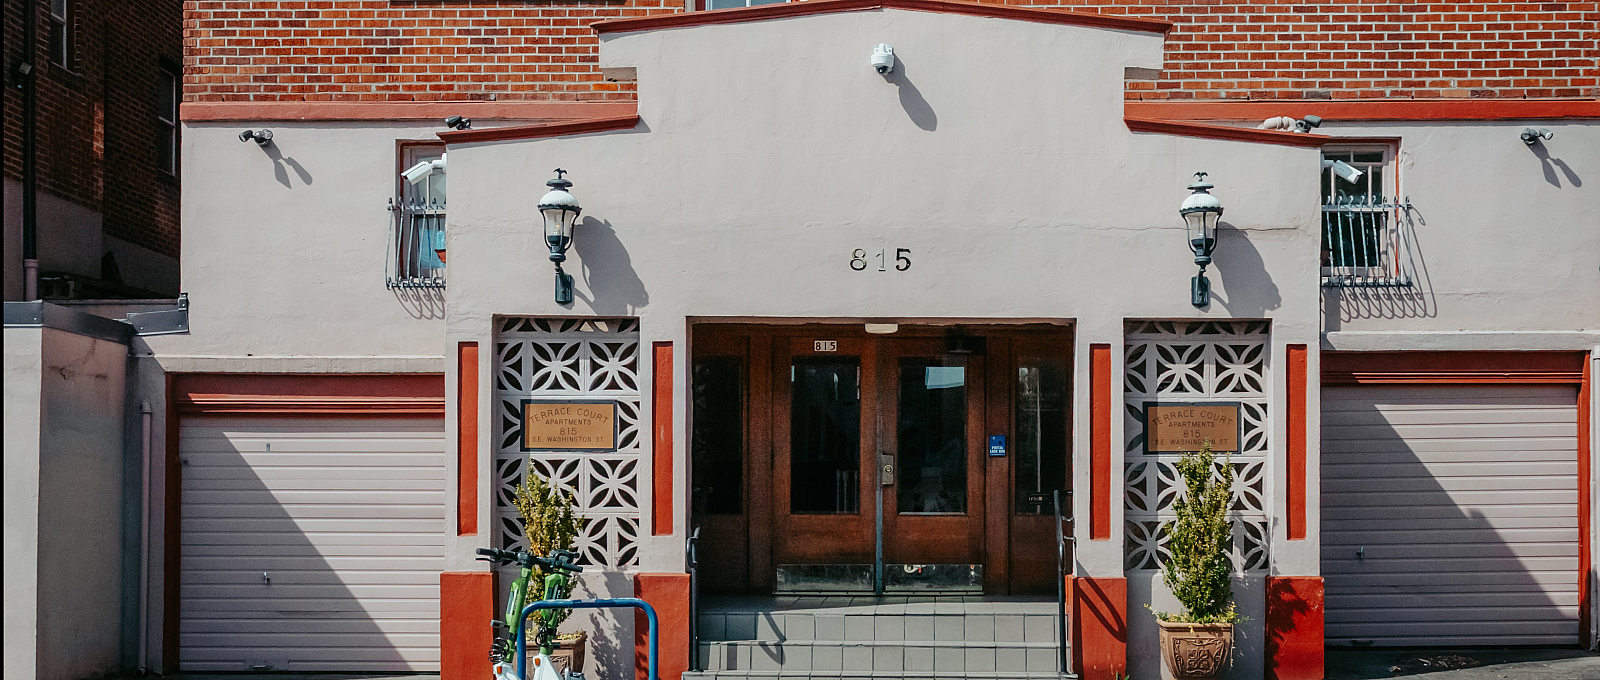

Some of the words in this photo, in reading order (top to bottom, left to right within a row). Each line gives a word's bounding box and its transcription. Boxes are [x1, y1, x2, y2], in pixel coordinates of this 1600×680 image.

[850, 248, 911, 271] 815
[816, 341, 835, 351] 815
[530, 407, 571, 423] TERRACE
[577, 408, 609, 423] COURT
[1152, 410, 1194, 427] TERRACE
[1200, 410, 1233, 426] COURT
[560, 427, 577, 435] 815
[1183, 430, 1200, 438] 815
